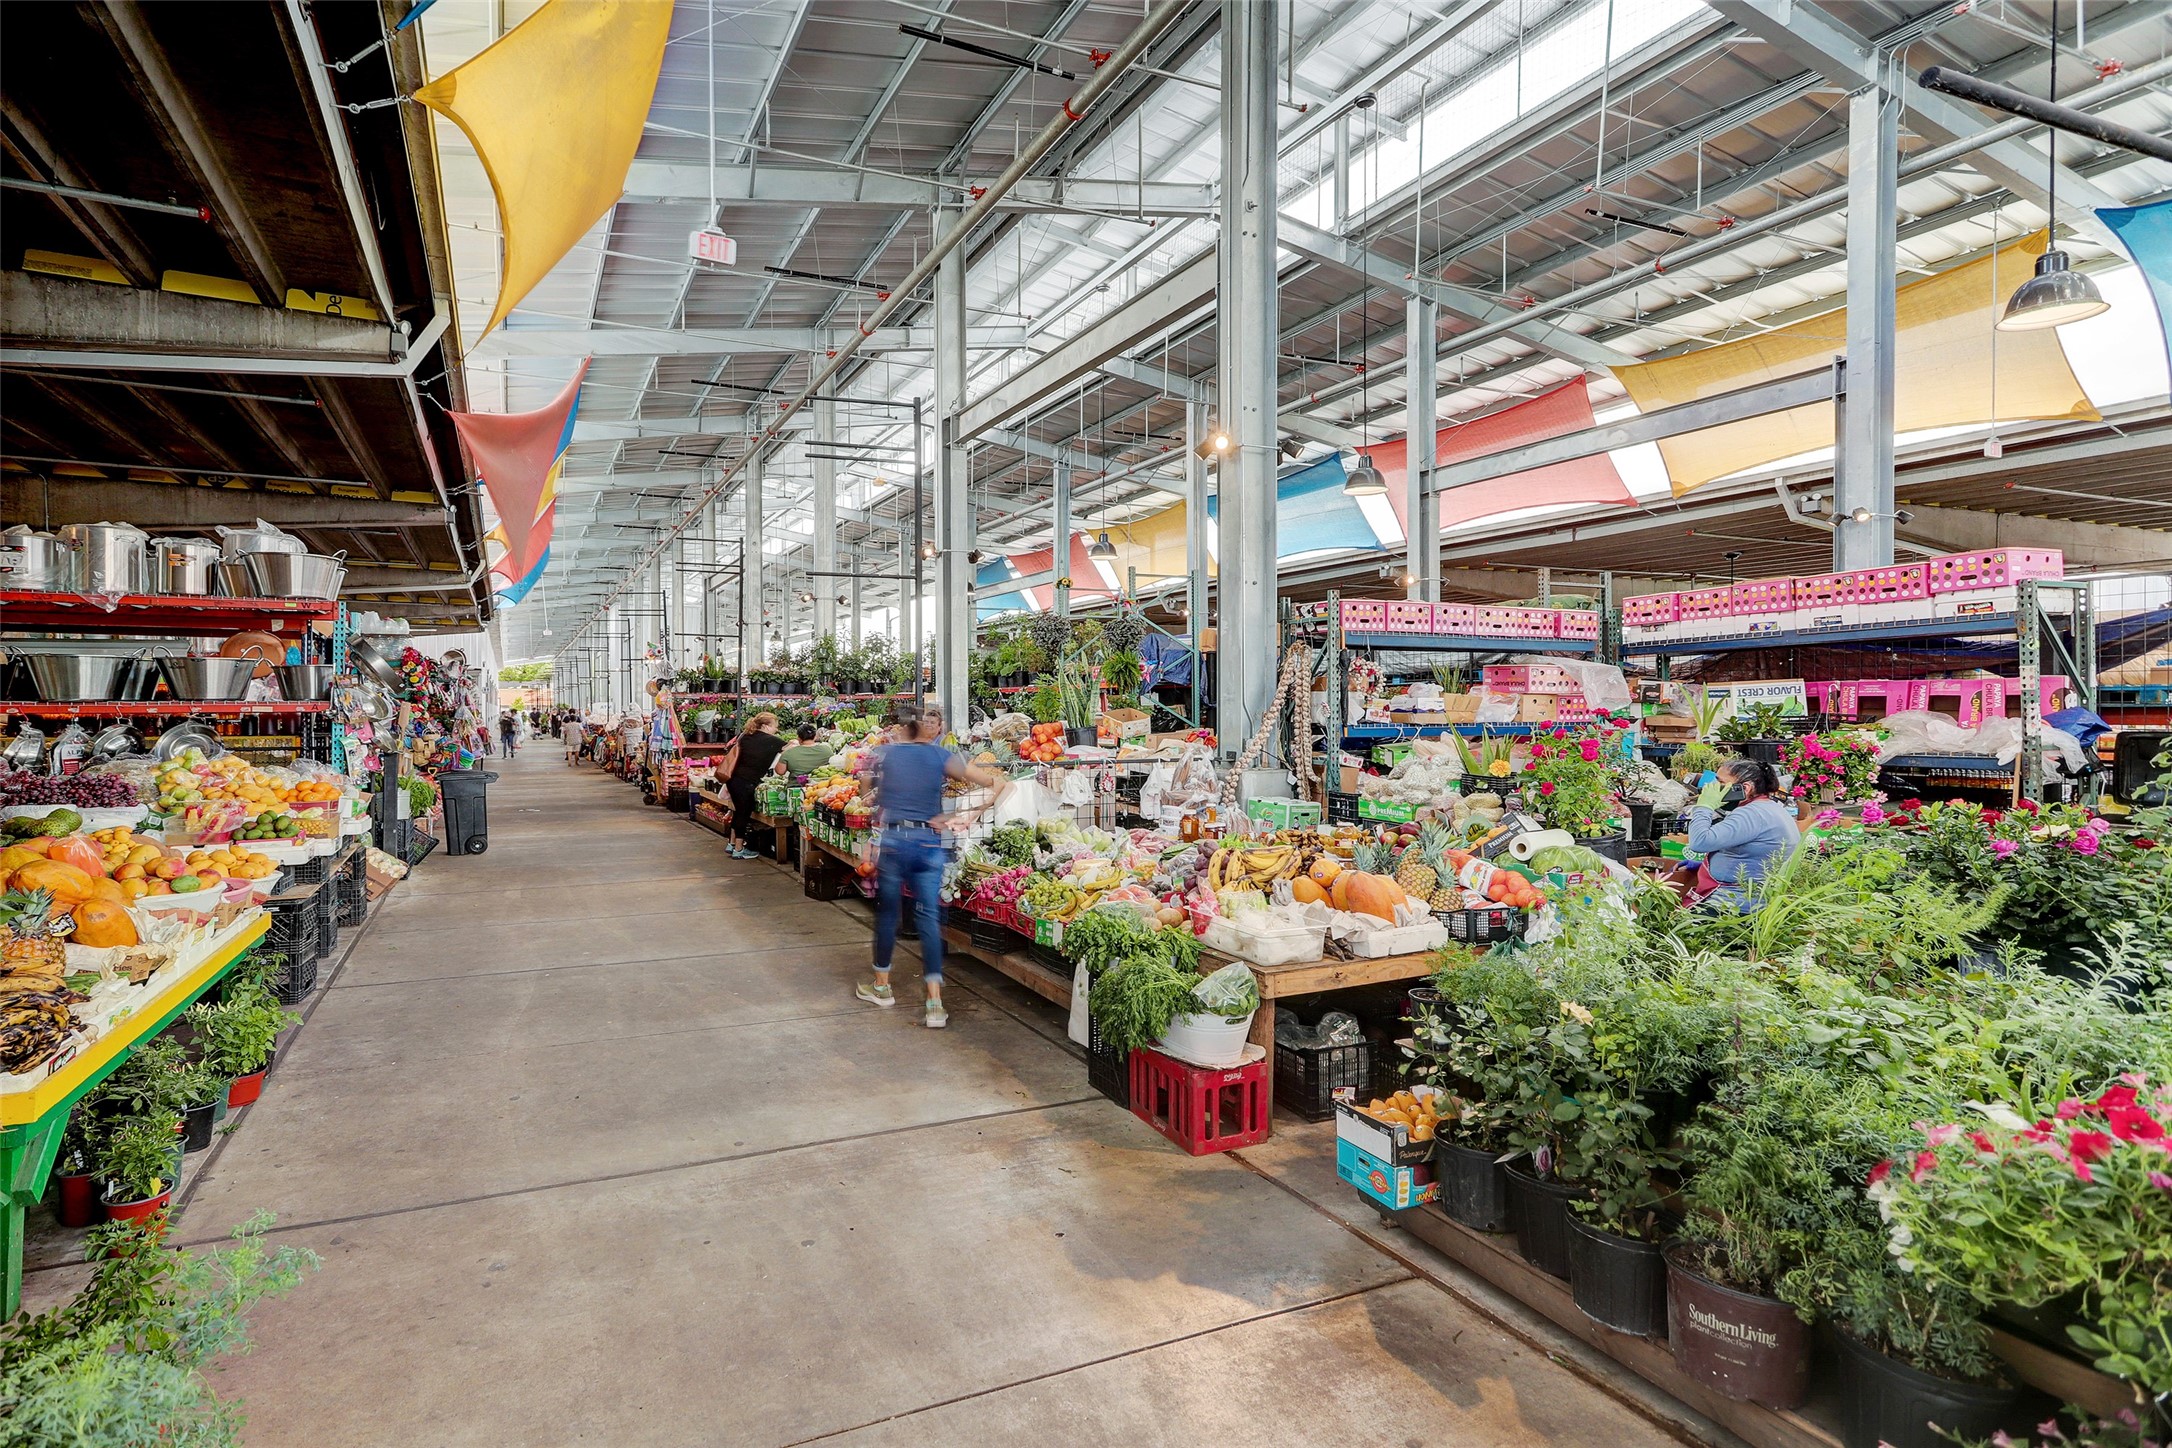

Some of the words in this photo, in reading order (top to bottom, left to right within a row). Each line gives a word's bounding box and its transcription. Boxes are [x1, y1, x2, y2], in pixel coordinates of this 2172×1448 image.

[698, 233, 731, 261] EXIT
[1737, 688, 1765, 698] CREST
[1767, 685, 1802, 696] FLAVOR
[1919, 685, 1927, 709] PAPAYA
[1985, 683, 1993, 706] CHULA
[1993, 683, 2001, 708] PAPAYA
[1487, 831, 1514, 849] PREMIUM
[1688, 1303, 1739, 1337] Southern
[1740, 1323, 1777, 1348] Living
